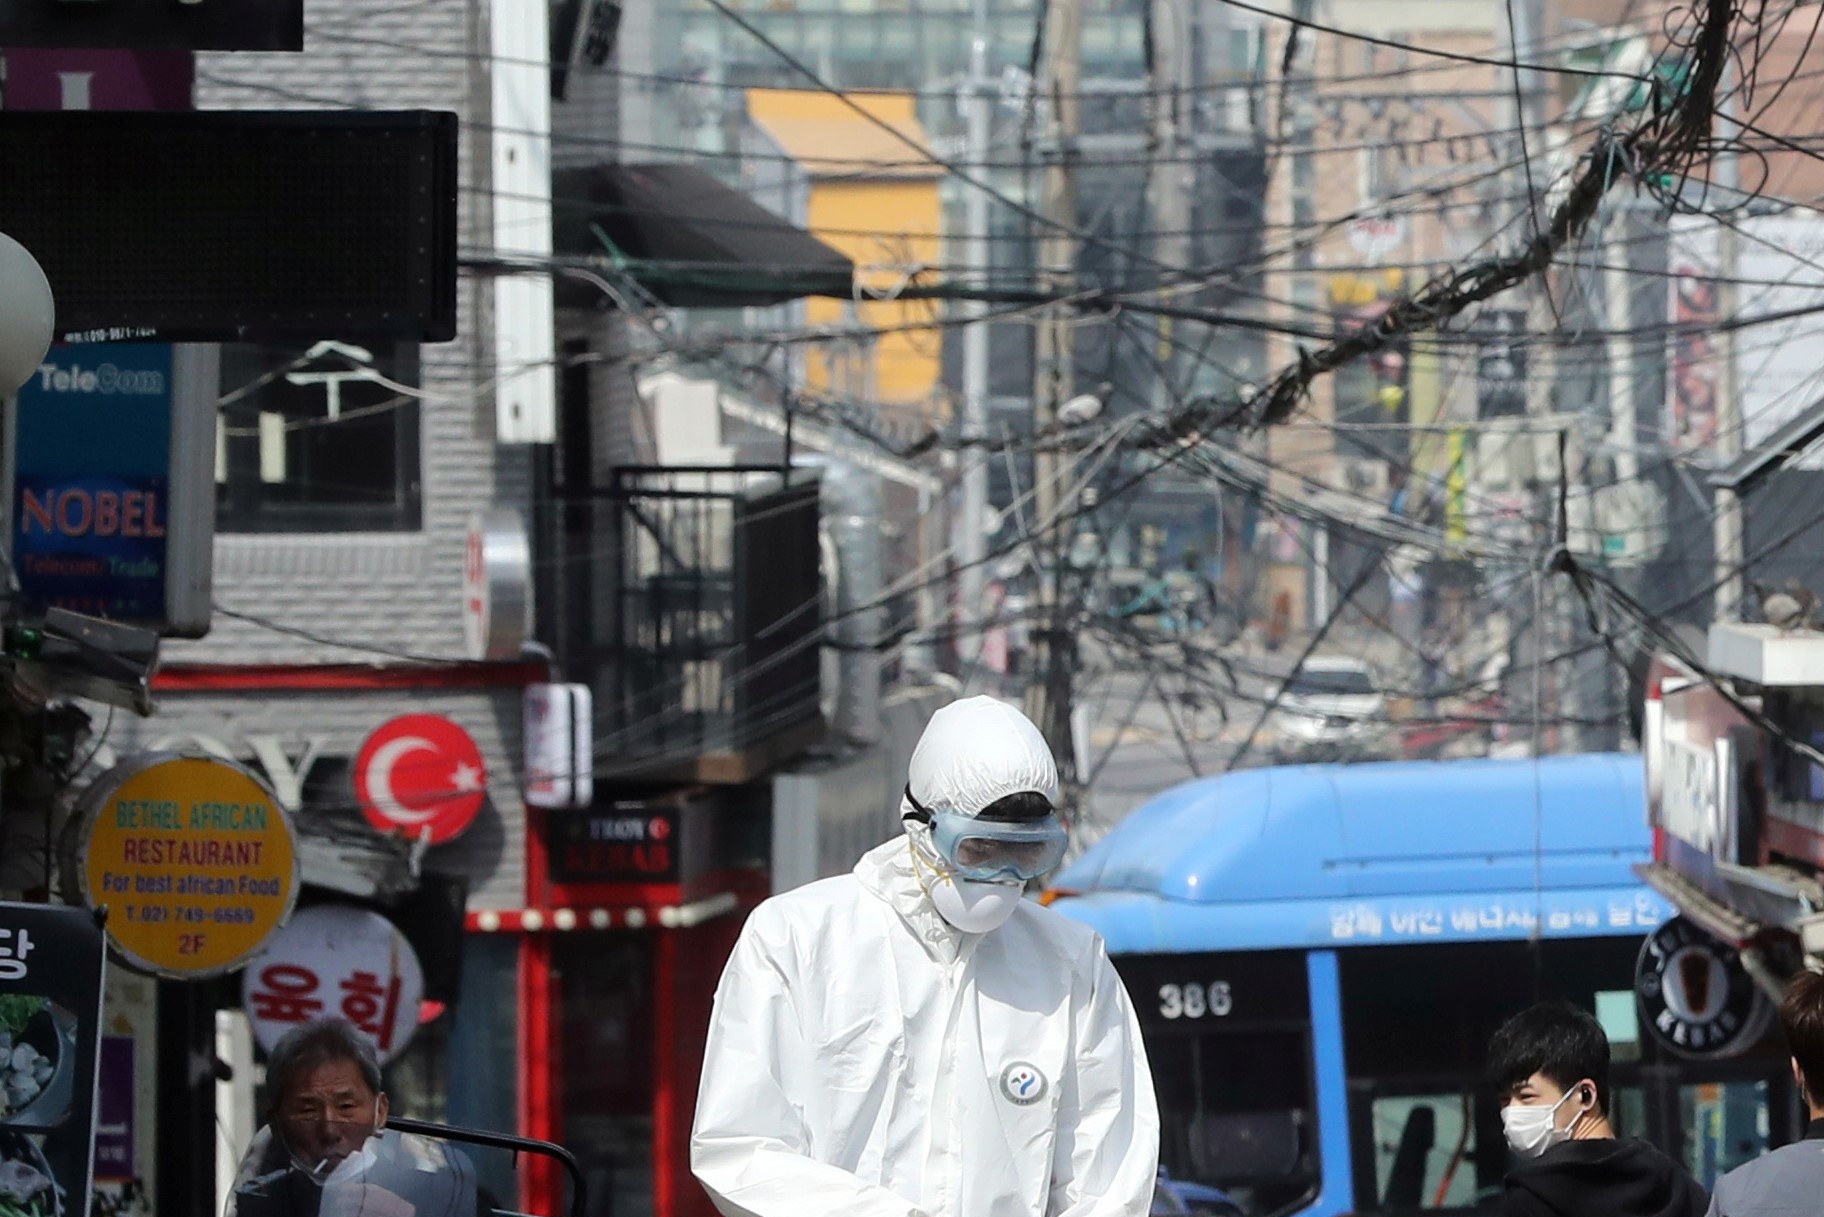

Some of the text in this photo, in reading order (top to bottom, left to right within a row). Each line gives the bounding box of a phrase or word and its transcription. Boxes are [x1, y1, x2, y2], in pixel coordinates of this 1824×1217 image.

[22, 487, 165, 537] NOBEL
[115, 801, 268, 832] BETHEL AFRICAN
[123, 838, 263, 867] RESTAURANT
[103, 872, 130, 893] For
[135, 873, 173, 894] best
[238, 875, 281, 897] Food
[178, 933, 207, 955] 2F
[1158, 981, 1233, 1020] 386
